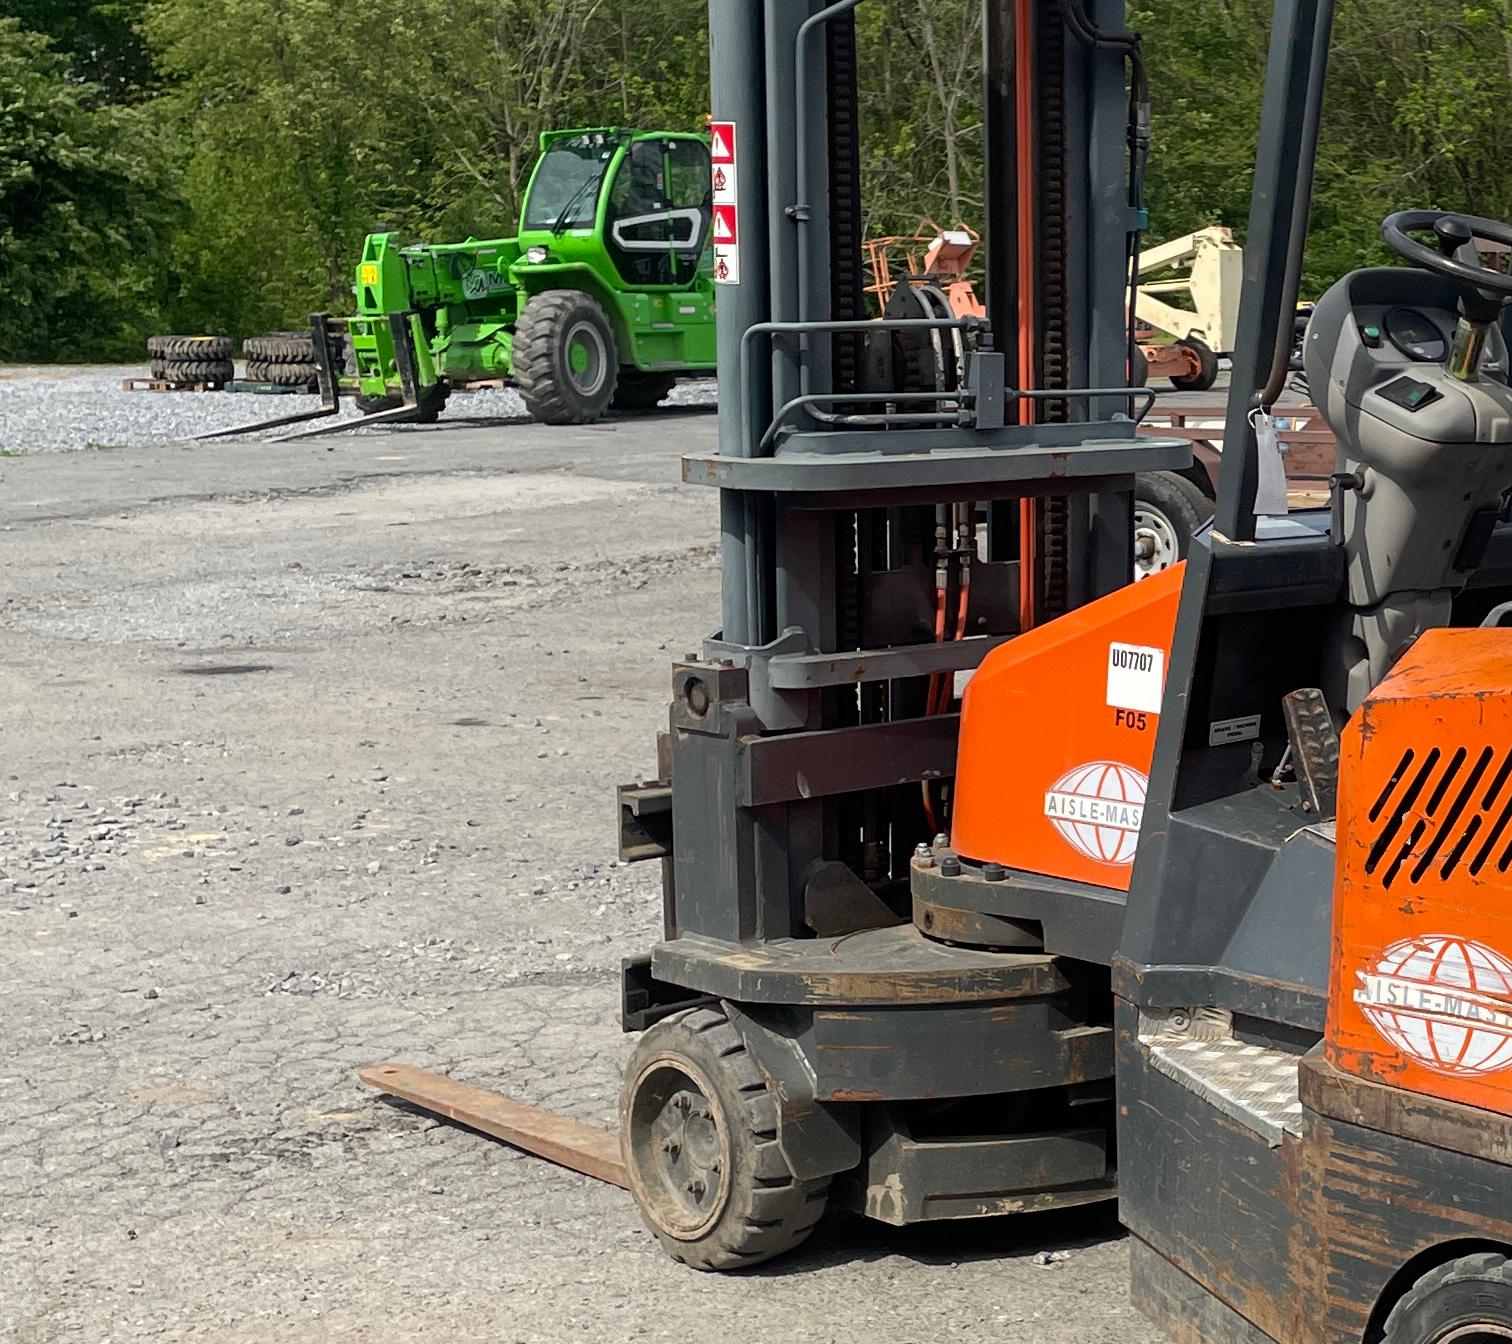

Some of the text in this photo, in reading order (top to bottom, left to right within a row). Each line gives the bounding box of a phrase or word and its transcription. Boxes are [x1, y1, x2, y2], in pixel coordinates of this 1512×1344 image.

[1111, 648, 1154, 672] U07707
[1114, 709, 1147, 731] F05
[1048, 795, 1139, 827] AISLE-MAS
